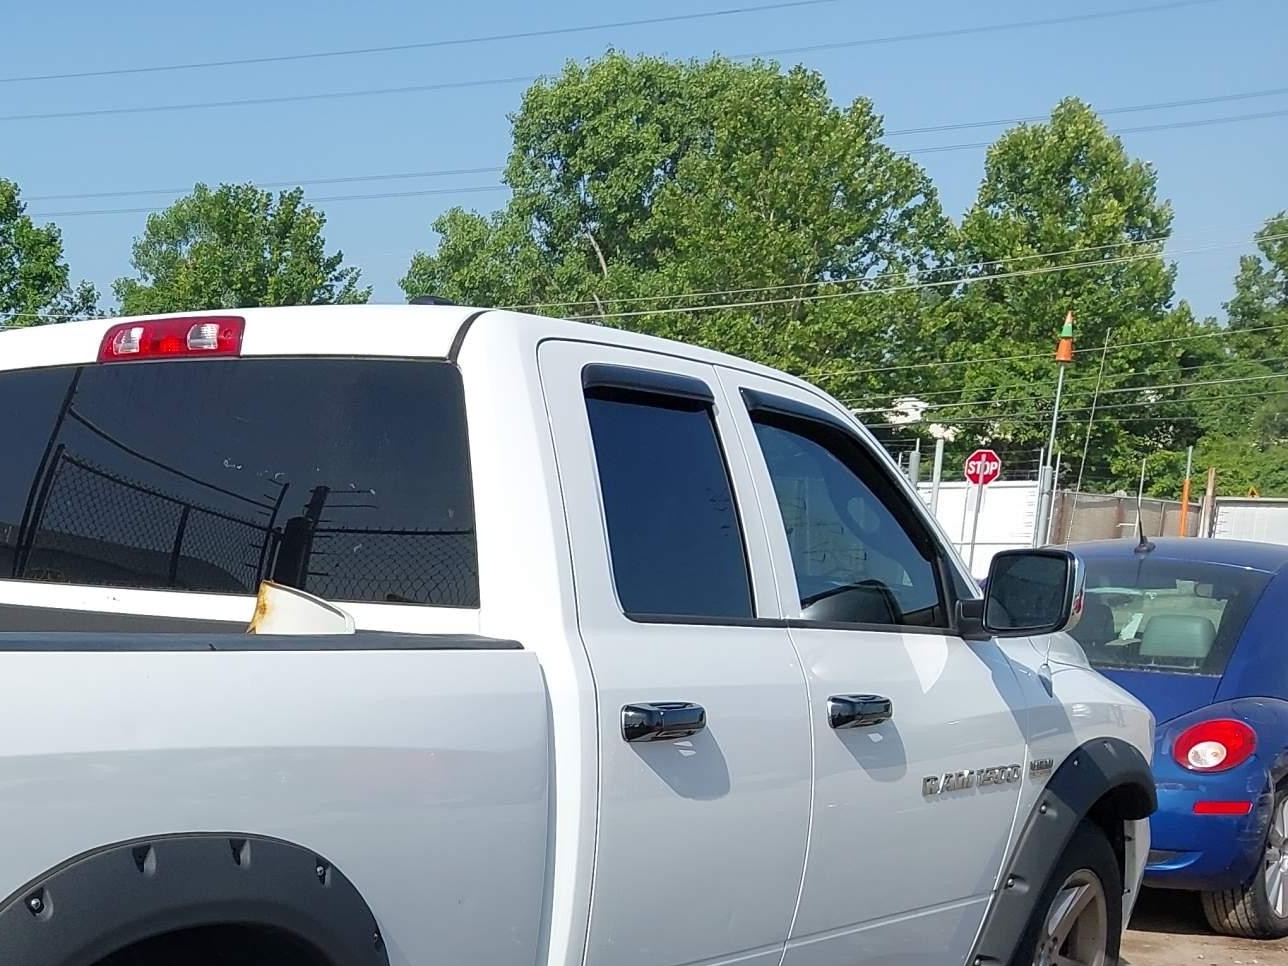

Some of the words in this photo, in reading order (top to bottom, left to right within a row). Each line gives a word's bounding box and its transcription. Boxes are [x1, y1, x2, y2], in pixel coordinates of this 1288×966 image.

[967, 461, 998, 475] STOP
[922, 769, 975, 796] RAM
[976, 763, 1021, 787] 1500
